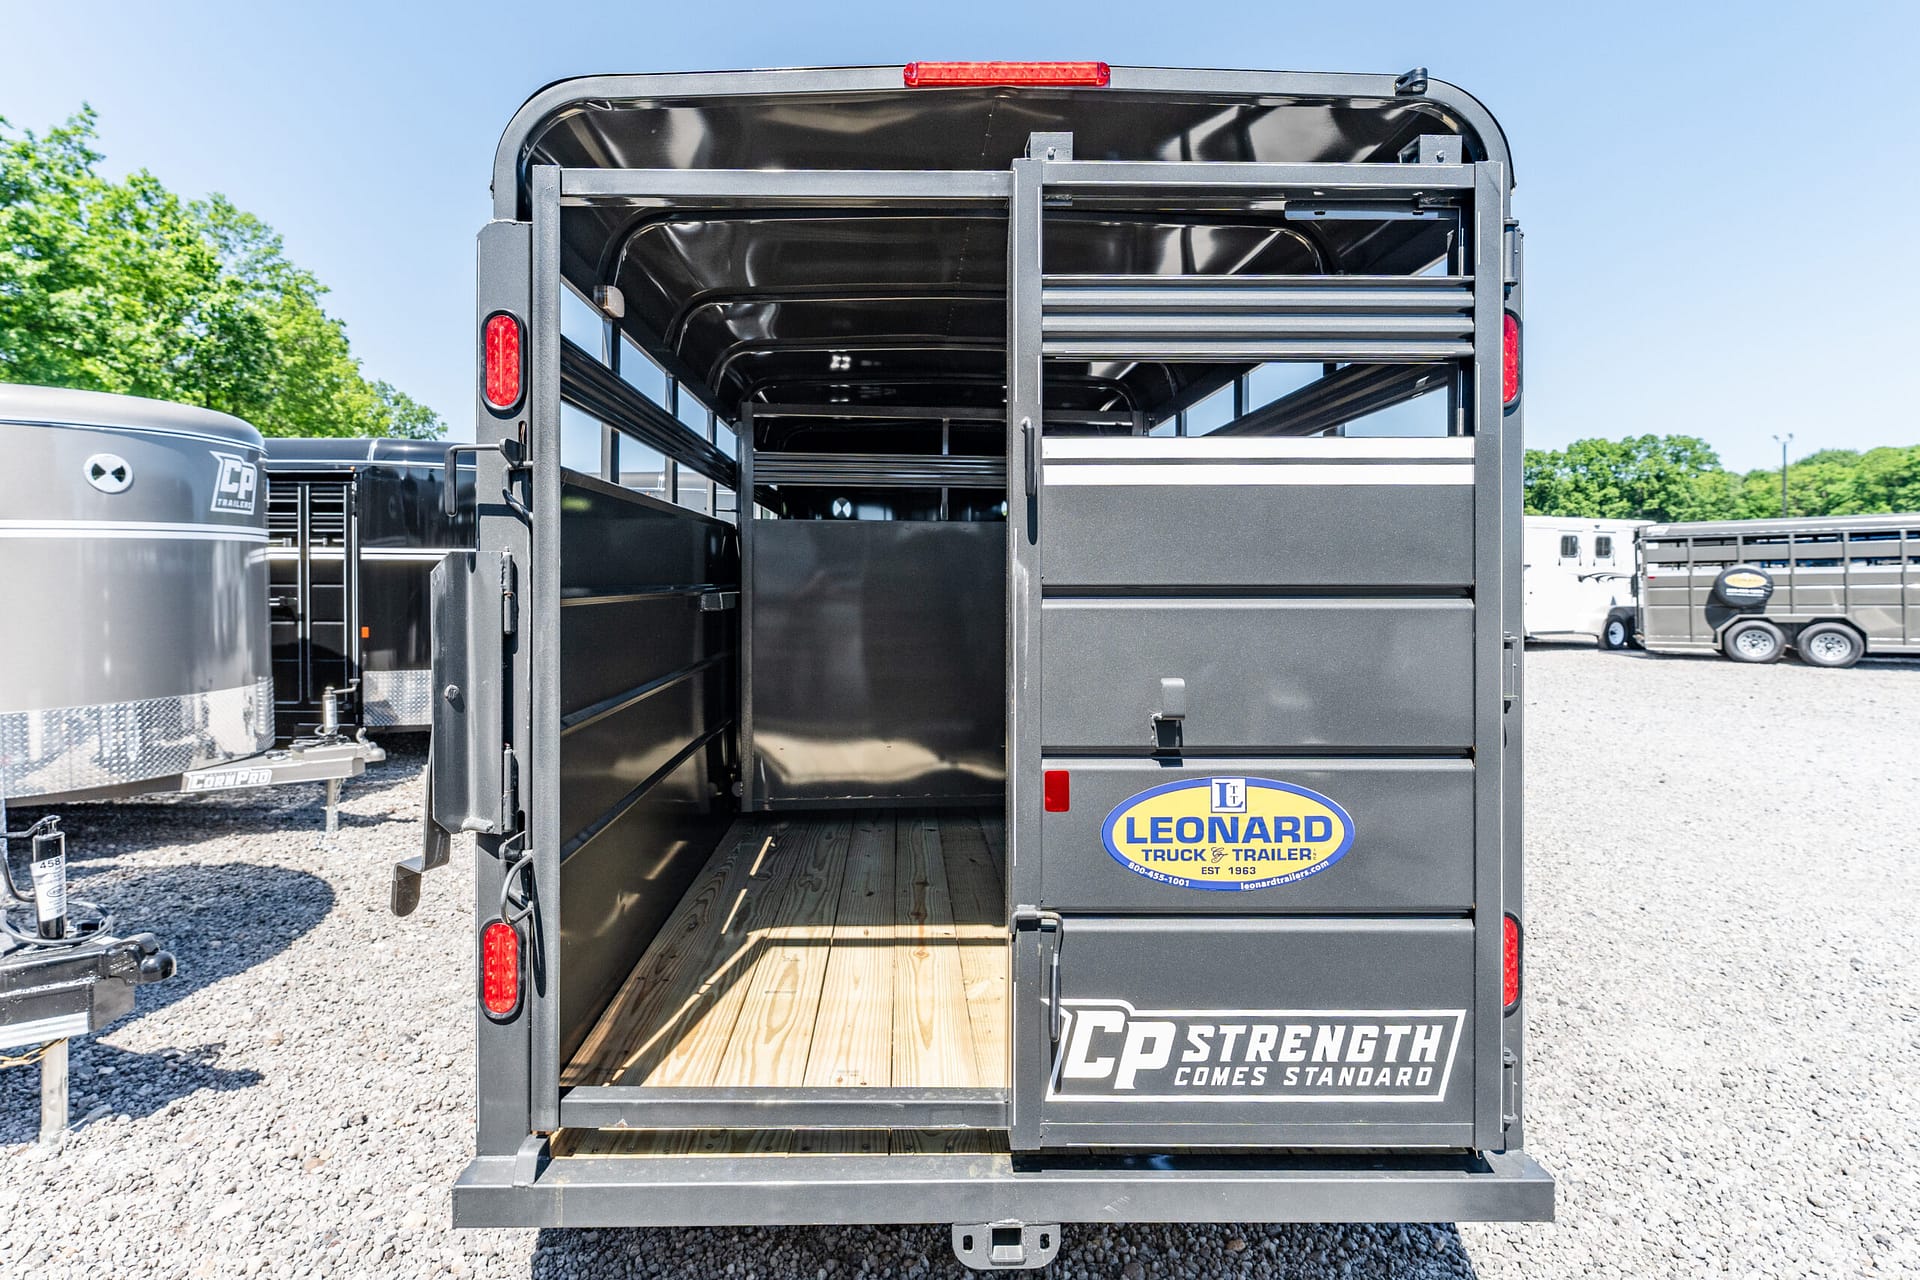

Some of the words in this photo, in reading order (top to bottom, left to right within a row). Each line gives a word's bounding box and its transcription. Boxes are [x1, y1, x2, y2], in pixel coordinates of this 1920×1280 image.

[220, 458, 255, 500] CP
[217, 498, 252, 509] TRAILERS
[1125, 815, 1333, 845] LEONARD
[40, 857, 61, 868] 458
[1141, 848, 1206, 862] TRUCK
[1232, 848, 1312, 861] TRAILER
[1127, 861, 1190, 887] 800-455-1001
[1201, 866, 1220, 875] EST
[1228, 866, 1256, 875] 1963
[1240, 860, 1329, 890] leonardtrailers.com
[1062, 1010, 1177, 1090] CP
[1181, 1024, 1443, 1063] STRENGTH
[1174, 1066, 1267, 1086] COMES
[1283, 1066, 1433, 1087] STANDARD
